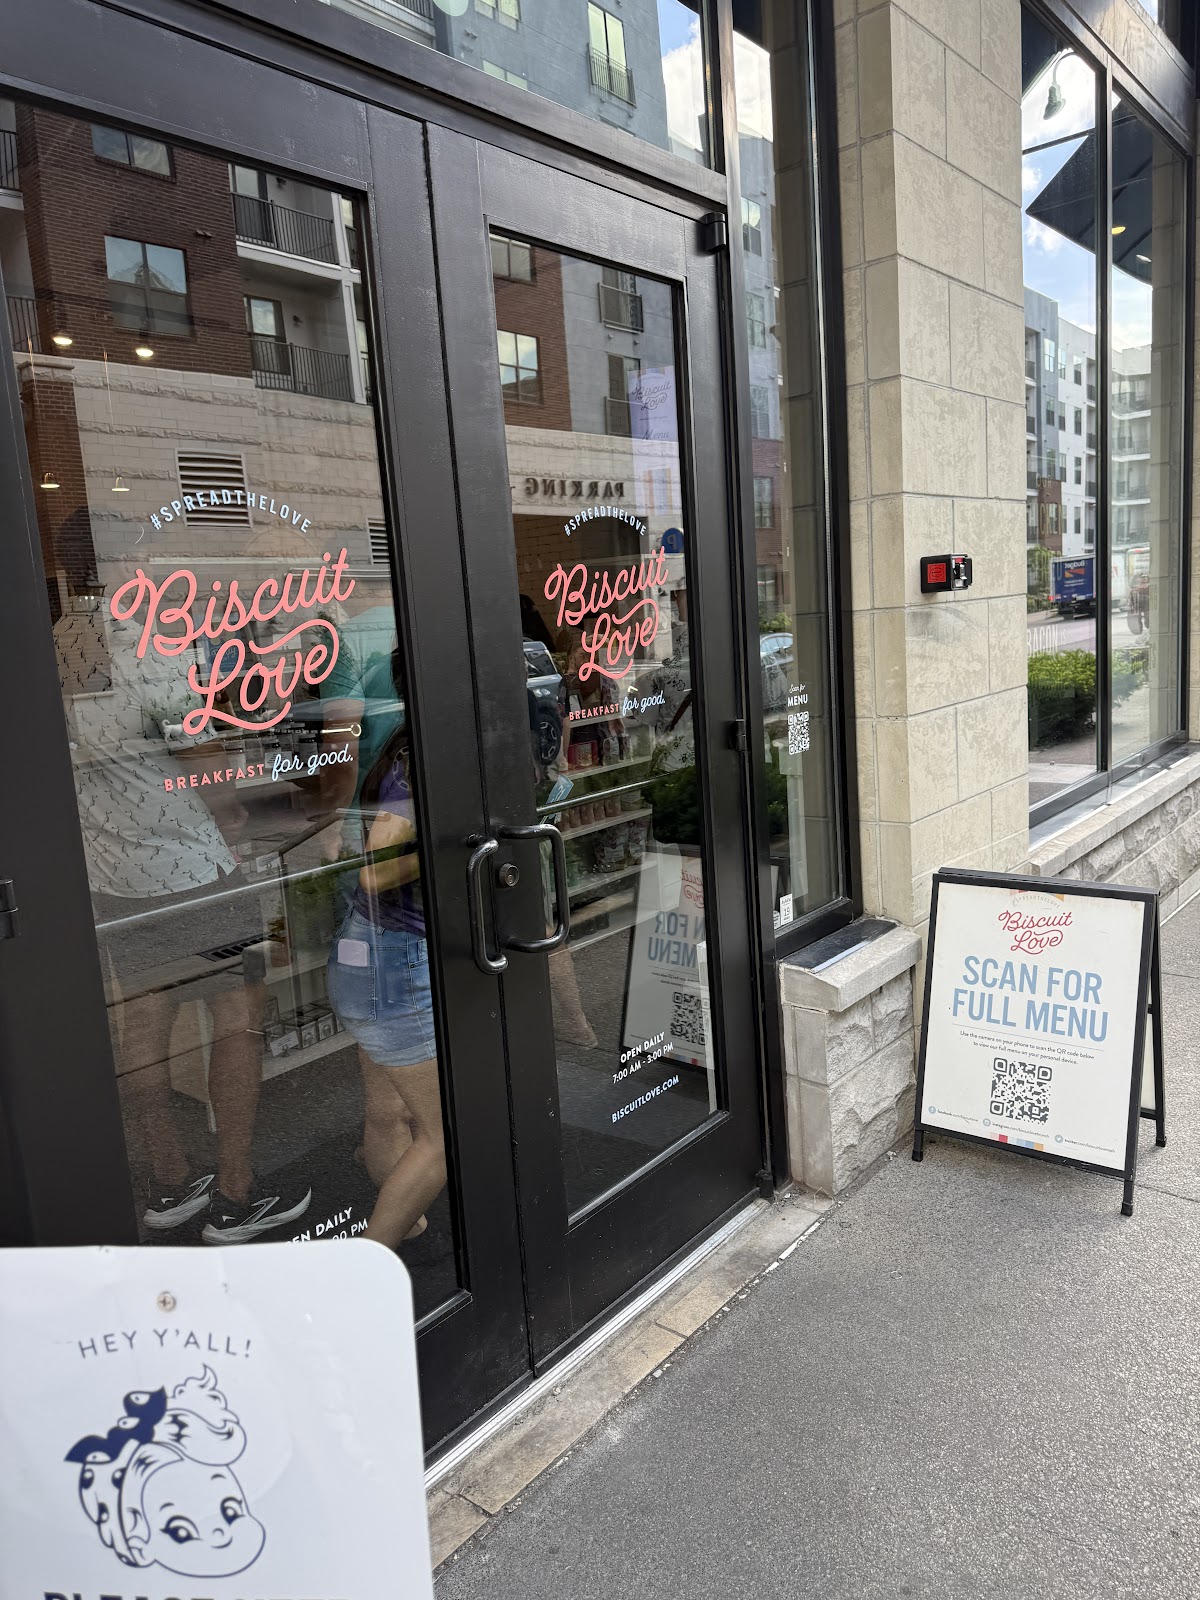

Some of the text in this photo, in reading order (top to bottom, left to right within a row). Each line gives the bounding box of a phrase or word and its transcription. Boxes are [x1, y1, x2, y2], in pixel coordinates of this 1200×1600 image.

[641, 392, 667, 410] Love
[642, 429, 669, 440] Menu
[150, 489, 311, 533] #SPREADTHELOVE
[564, 505, 647, 537] #SPREADTHELOVE
[544, 545, 669, 627] Biscuit
[110, 547, 355, 659] Biscuit
[578, 598, 659, 682] Love
[183, 618, 339, 735] Love
[569, 691, 666, 721] BREAKFAST for good.
[787, 694, 808, 707] MENU
[164, 763, 265, 792] BREAKFAST
[271, 753, 304, 781] for
[307, 744, 354, 775] good.
[998, 910, 1073, 931] Biscuit
[1010, 929, 1064, 955] Love
[962, 955, 1102, 1005] SCAN FOR
[952, 988, 1108, 1042] FULL MENU
[612, 1068, 628, 1084] 7:00
[629, 1060, 642, 1075] AM
[647, 1048, 662, 1064] 3:00
[663, 1042, 674, 1055] PM
[620, 1032, 665, 1063] OPEN DAILY
[611, 1074, 680, 1123] BISCUITLOVE.COM
[315, 1206, 352, 1237] DAILY
[351, 1218, 368, 1236] PM
[79, 1328, 253, 1358] HEY Y'ALL!
